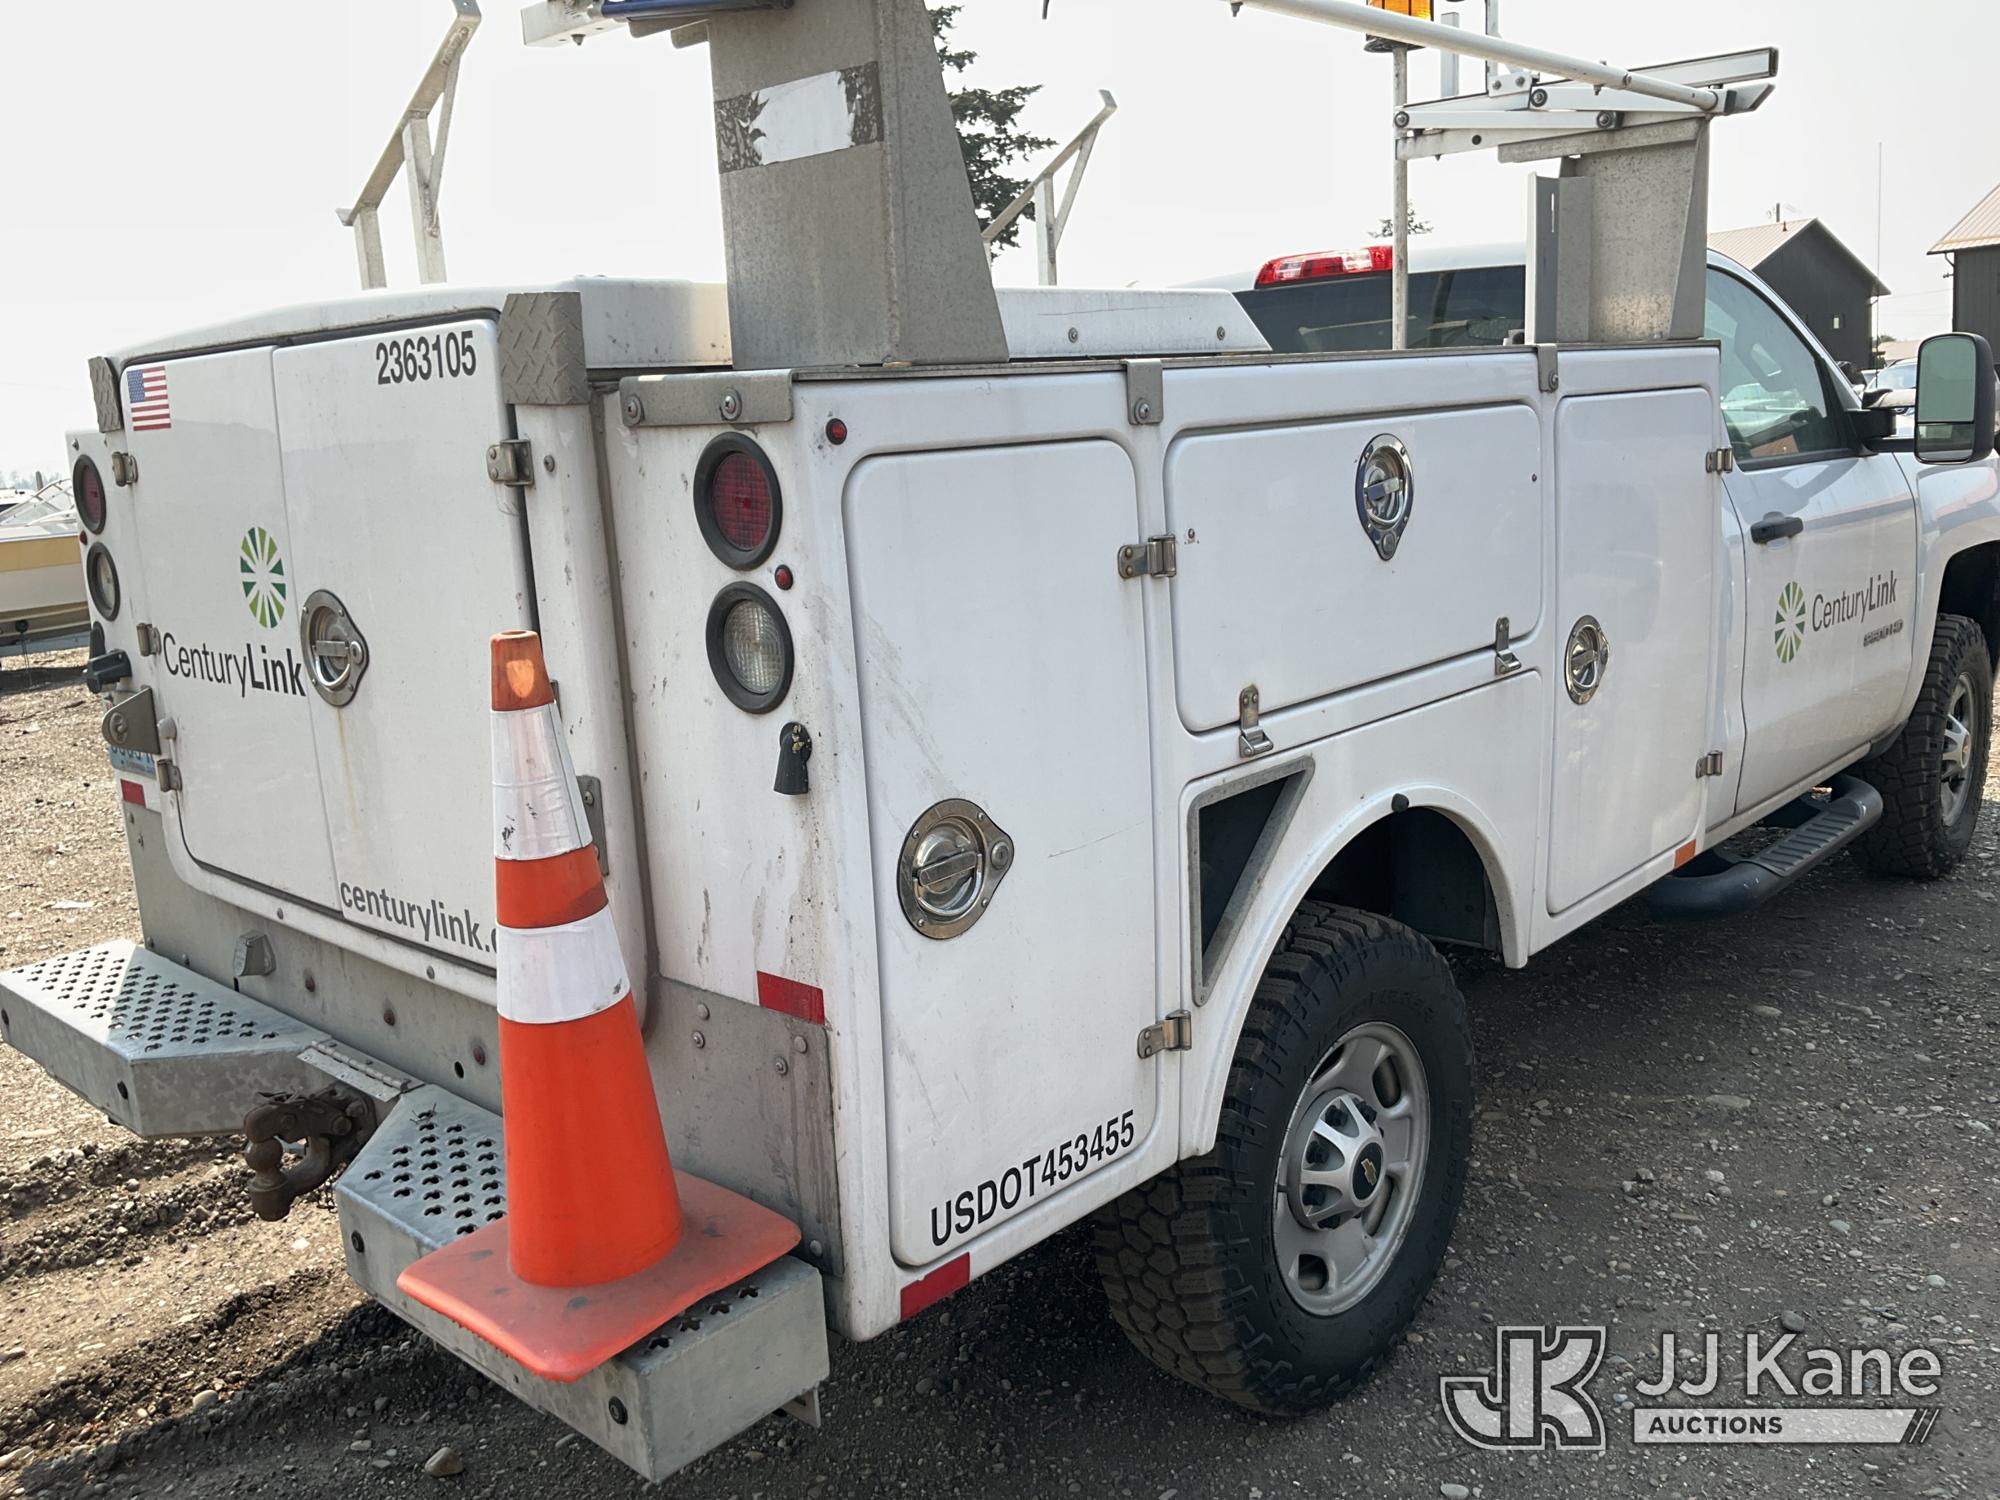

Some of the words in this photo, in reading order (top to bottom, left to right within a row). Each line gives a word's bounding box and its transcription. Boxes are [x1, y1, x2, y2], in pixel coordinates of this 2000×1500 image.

[376, 330, 476, 385] 2363105
[1812, 570, 1897, 632] CenturyLink
[163, 632, 306, 698] CenturyLink
[931, 1109, 1134, 1246] USDOT453455
